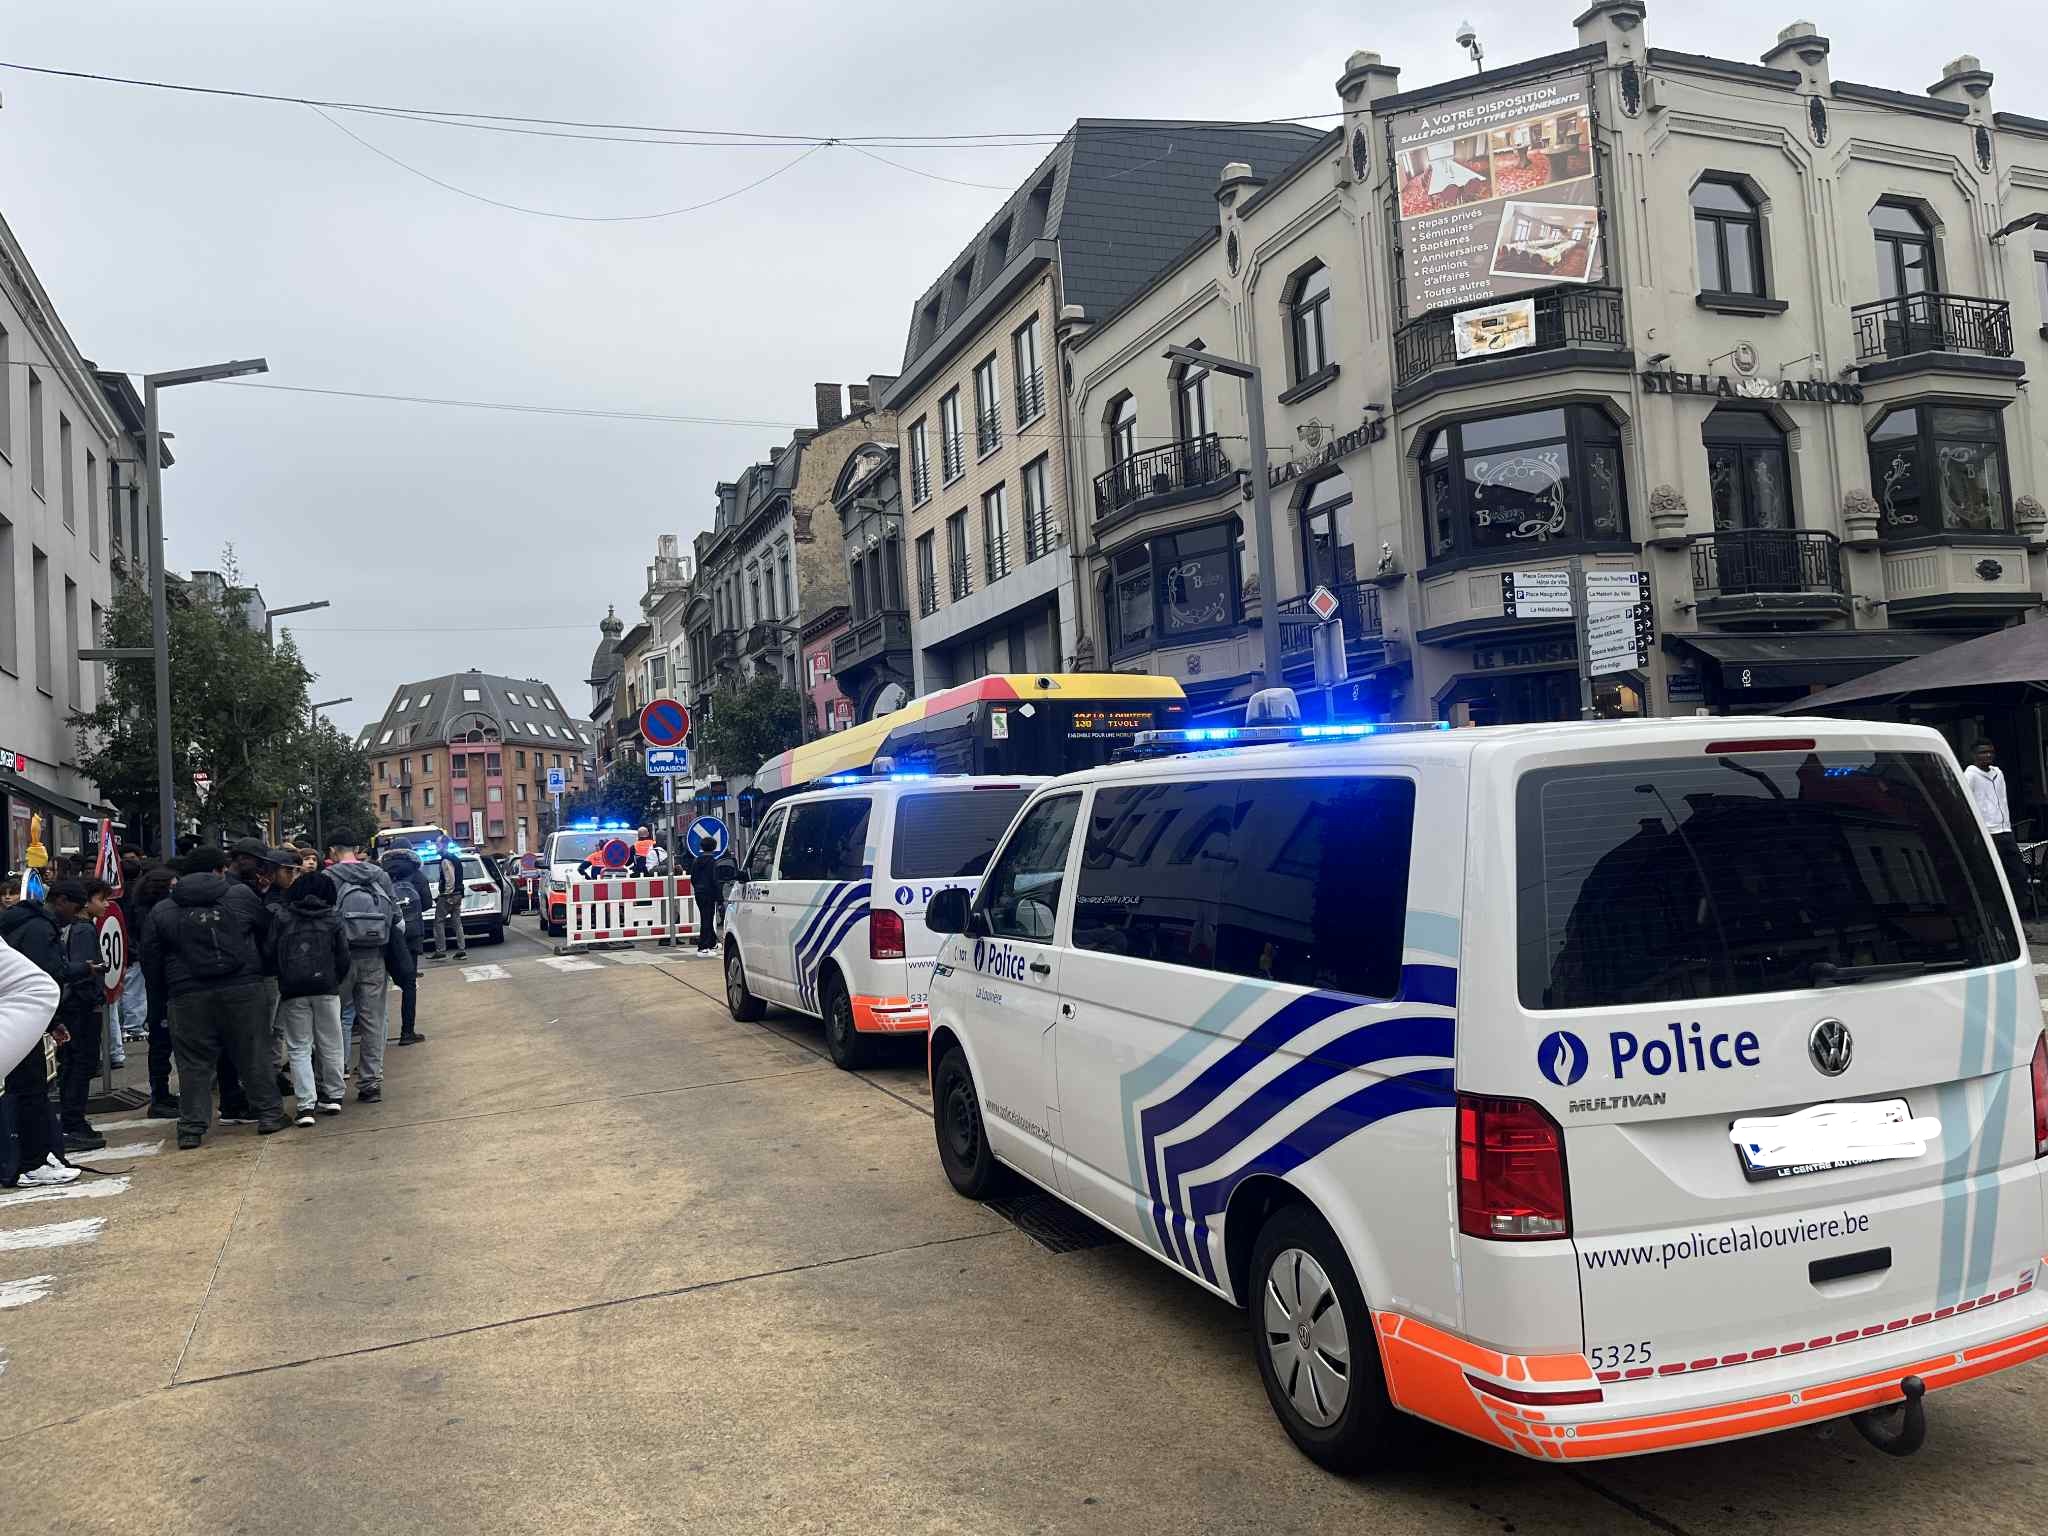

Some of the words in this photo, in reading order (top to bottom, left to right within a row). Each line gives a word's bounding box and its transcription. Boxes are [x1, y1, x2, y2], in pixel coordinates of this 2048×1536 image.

[1401, 131, 1430, 144] SALLE
[1430, 123, 1456, 137] POUR
[1457, 117, 1483, 131] TOUT
[1483, 111, 1507, 125] TYPE
[1508, 92, 1580, 118] D'ÉVÉNEMENTS
[1421, 118, 1430, 129] À
[1433, 107, 1474, 126] VOTRE
[1477, 87, 1557, 115] DISPOSITION
[1418, 217, 1449, 230] Repas
[1451, 208, 1482, 223] privés
[1419, 223, 1473, 240] Séminaires
[1420, 235, 1470, 252] Baptêmes
[1421, 243, 1489, 264] Anniversaires
[1422, 260, 1468, 276] Réunions
[1424, 271, 1470, 286] d'affaires
[1424, 286, 1456, 298] Toutes
[1459, 279, 1490, 292] autres
[1426, 290, 1495, 310] organisations
[1643, 371, 1732, 397] STELLA
[1782, 379, 1864, 405] ARTOIS
[1327, 420, 1386, 462] ARTOIS
[649, 765, 688, 773] LIVRAISON
[101, 931, 121, 973] 30
[988, 943, 1025, 981] Police
[911, 993, 928, 1003] 532
[1610, 1021, 1761, 1079] Police
[1569, 1092, 1666, 1113] MULTIVAN
[1777, 1168, 1791, 1177] LE
[1793, 1161, 1832, 1175] CENTRE
[1584, 1210, 1869, 1270] www.policelalouviere.be
[1591, 1341, 1652, 1370] 5325
